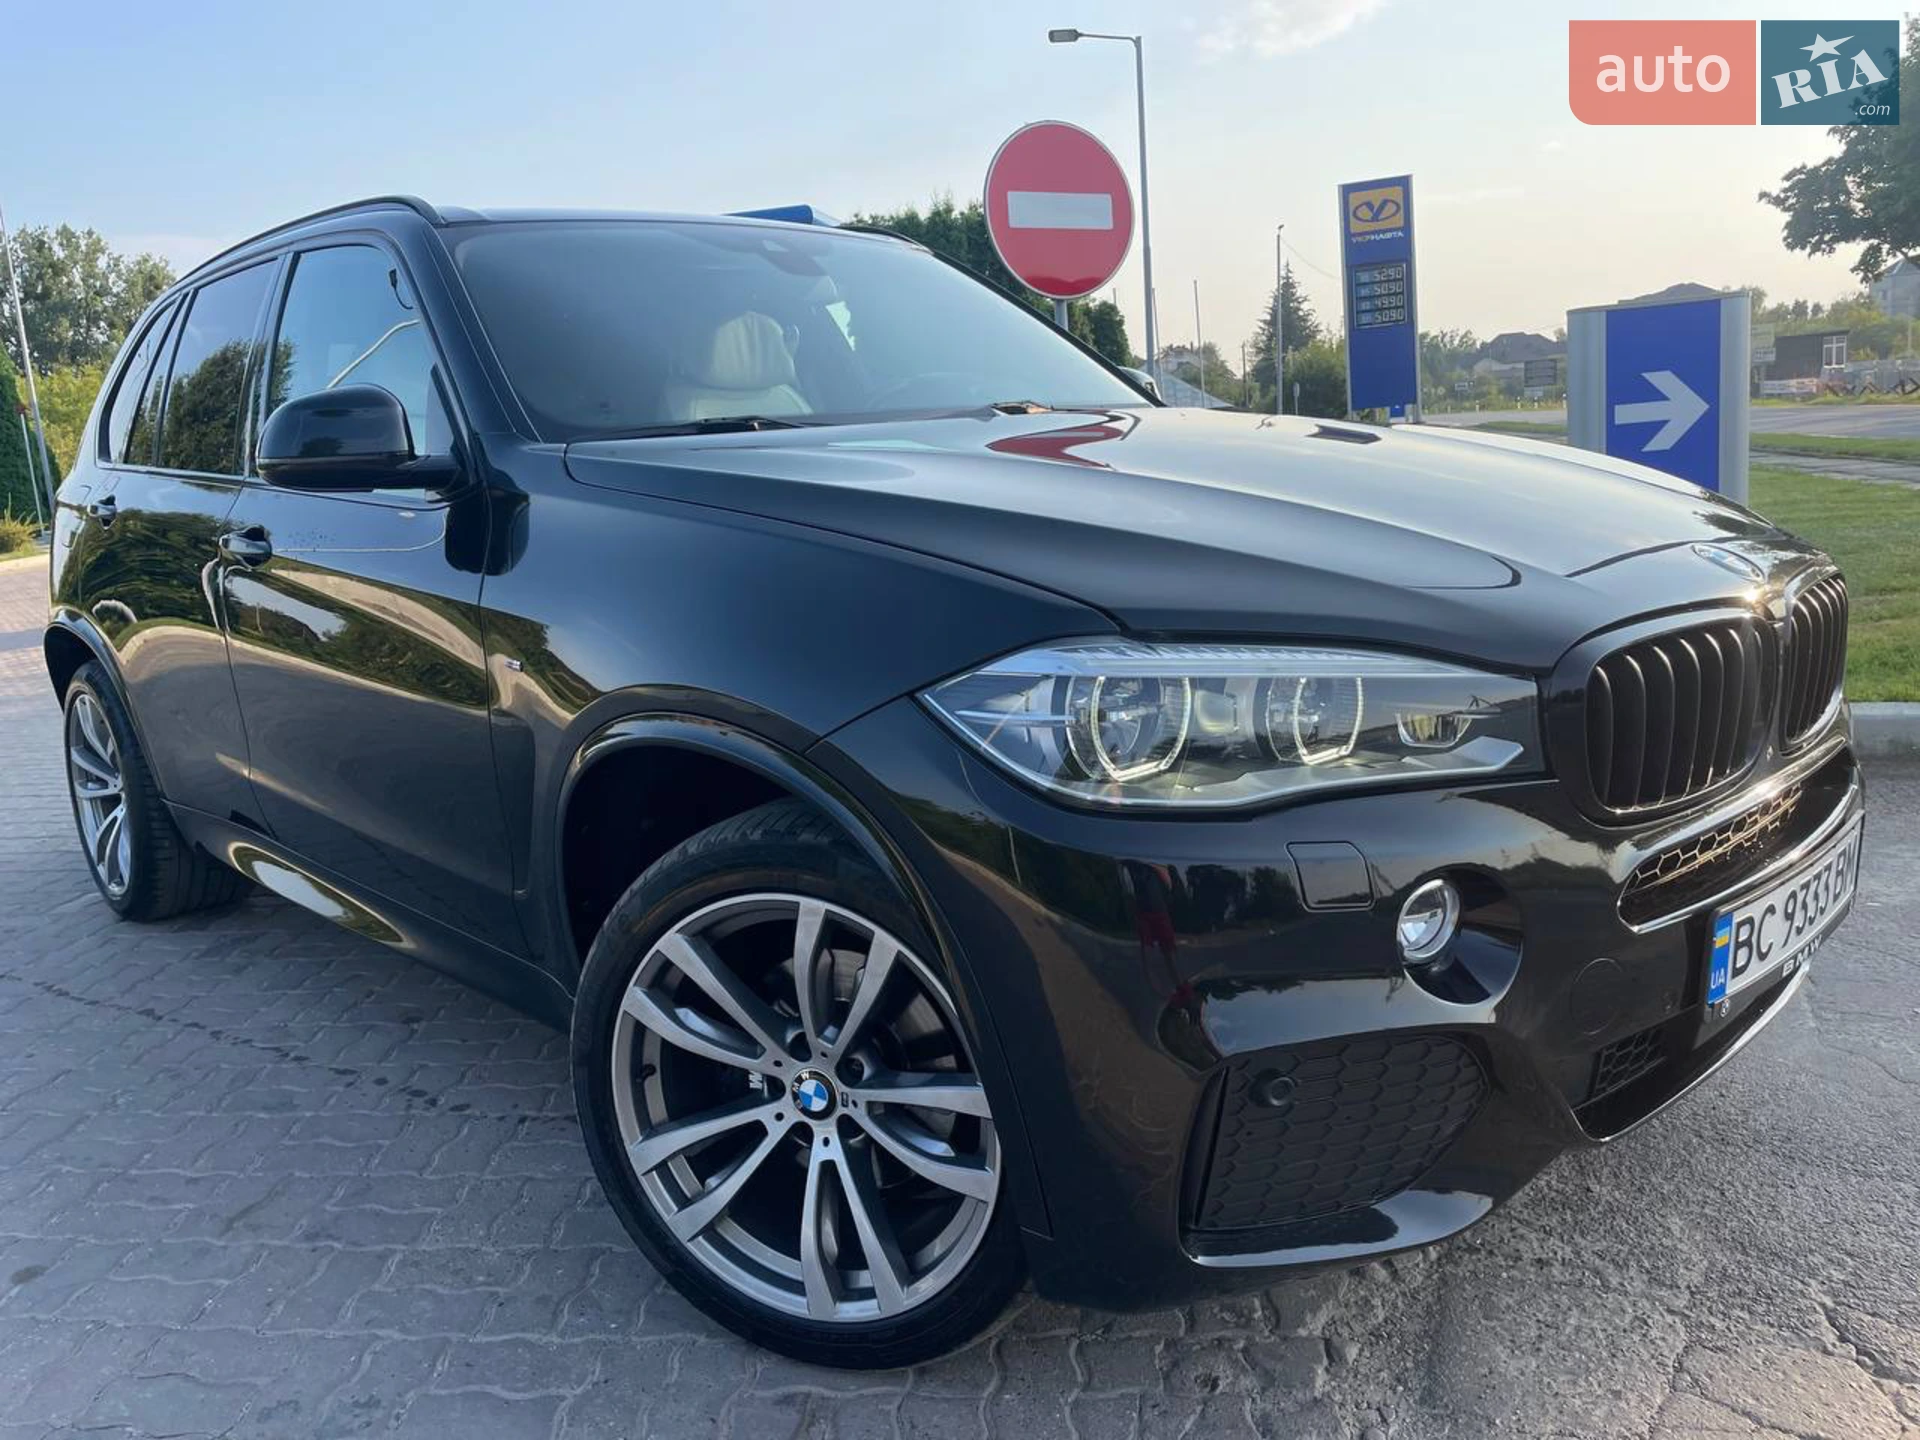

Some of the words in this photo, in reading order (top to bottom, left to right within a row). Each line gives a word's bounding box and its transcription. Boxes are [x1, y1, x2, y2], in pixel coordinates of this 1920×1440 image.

[1731, 903, 1776, 981] BC
[1781, 860, 1833, 949] 9333
[1711, 967, 1726, 989] UA
